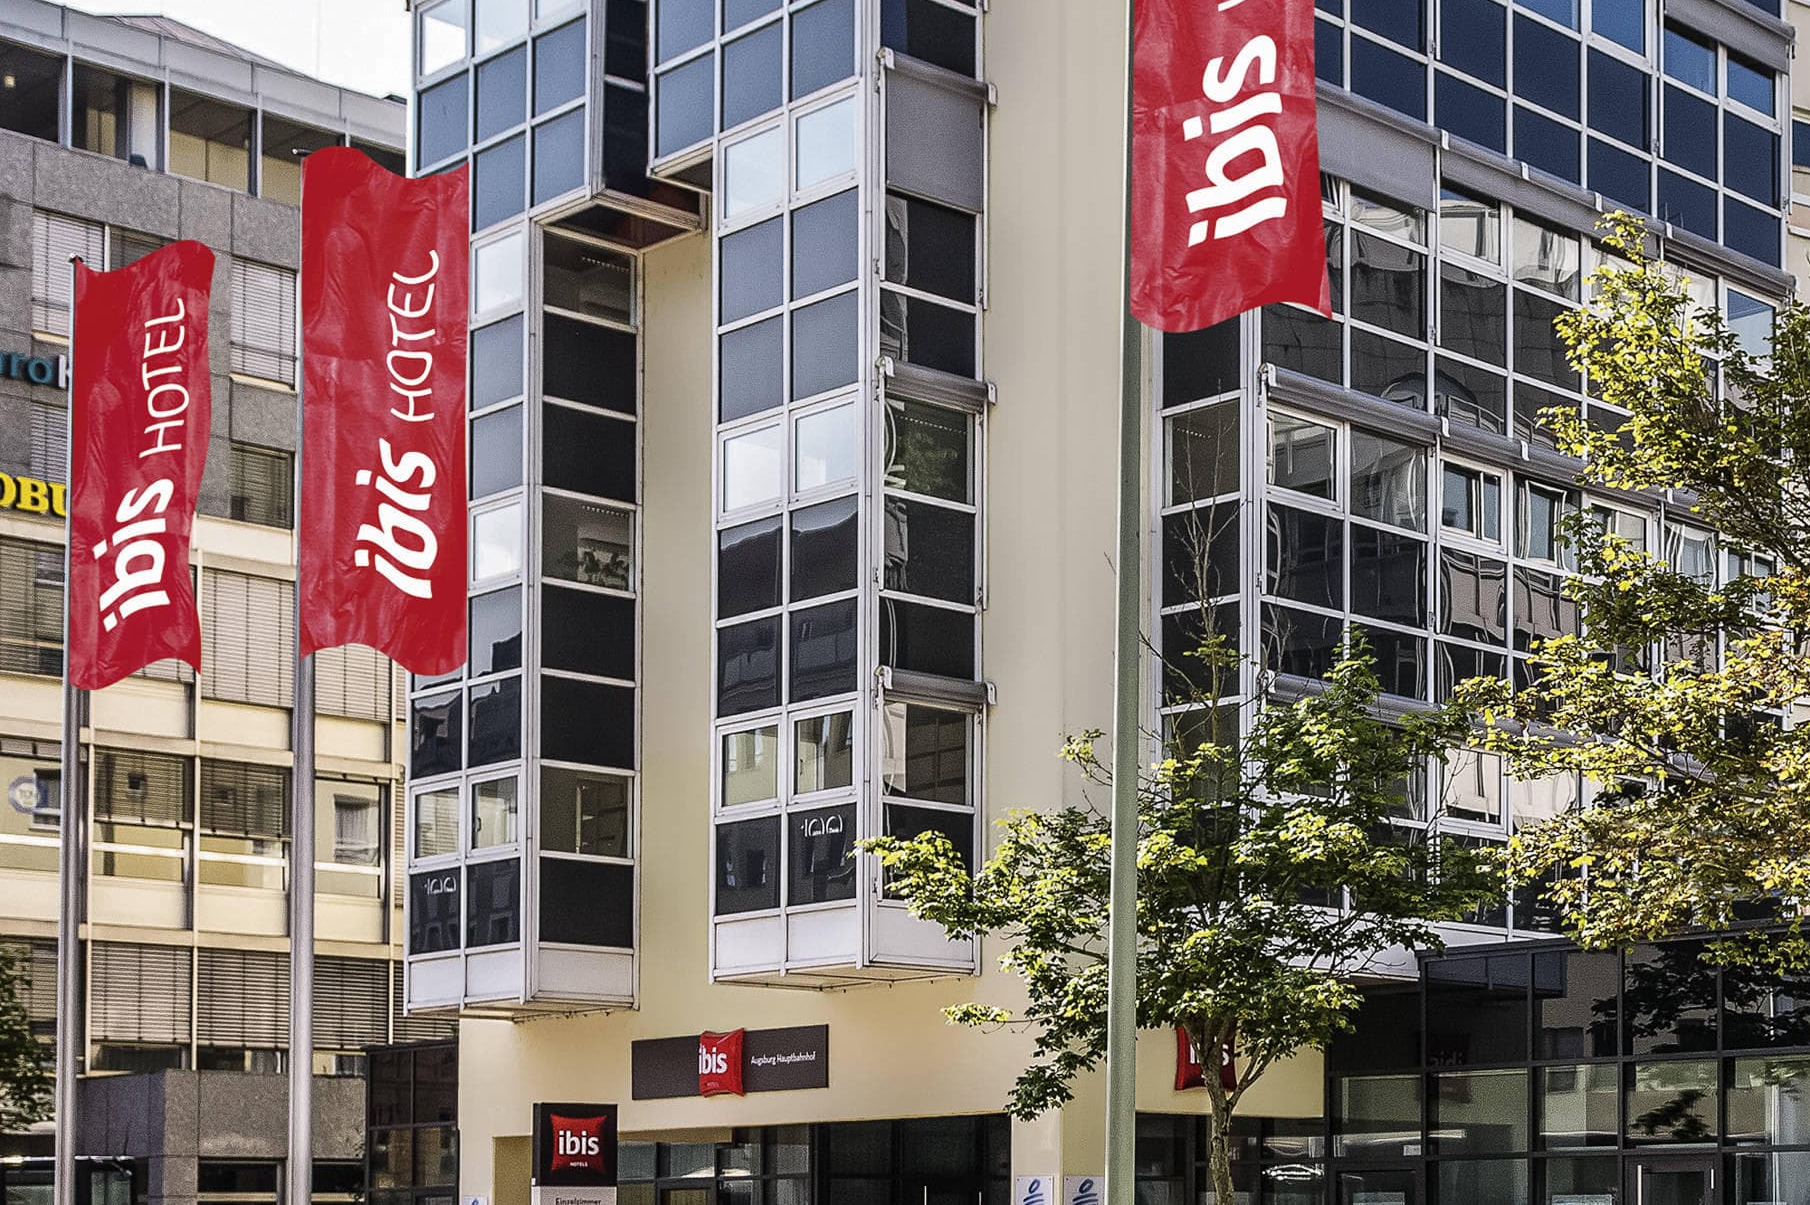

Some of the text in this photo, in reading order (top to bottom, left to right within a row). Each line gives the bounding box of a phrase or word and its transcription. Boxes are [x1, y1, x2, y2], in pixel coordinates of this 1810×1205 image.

[1183, 36, 1286, 247] ibis
[0, 352, 68, 389] ro
[355, 250, 439, 598] ibis HOTEL
[93, 299, 189, 631] ibis HOTEL
[698, 1043, 728, 1074] ibis
[751, 1054, 776, 1066] Augsburg
[558, 1130, 600, 1155] ibis
